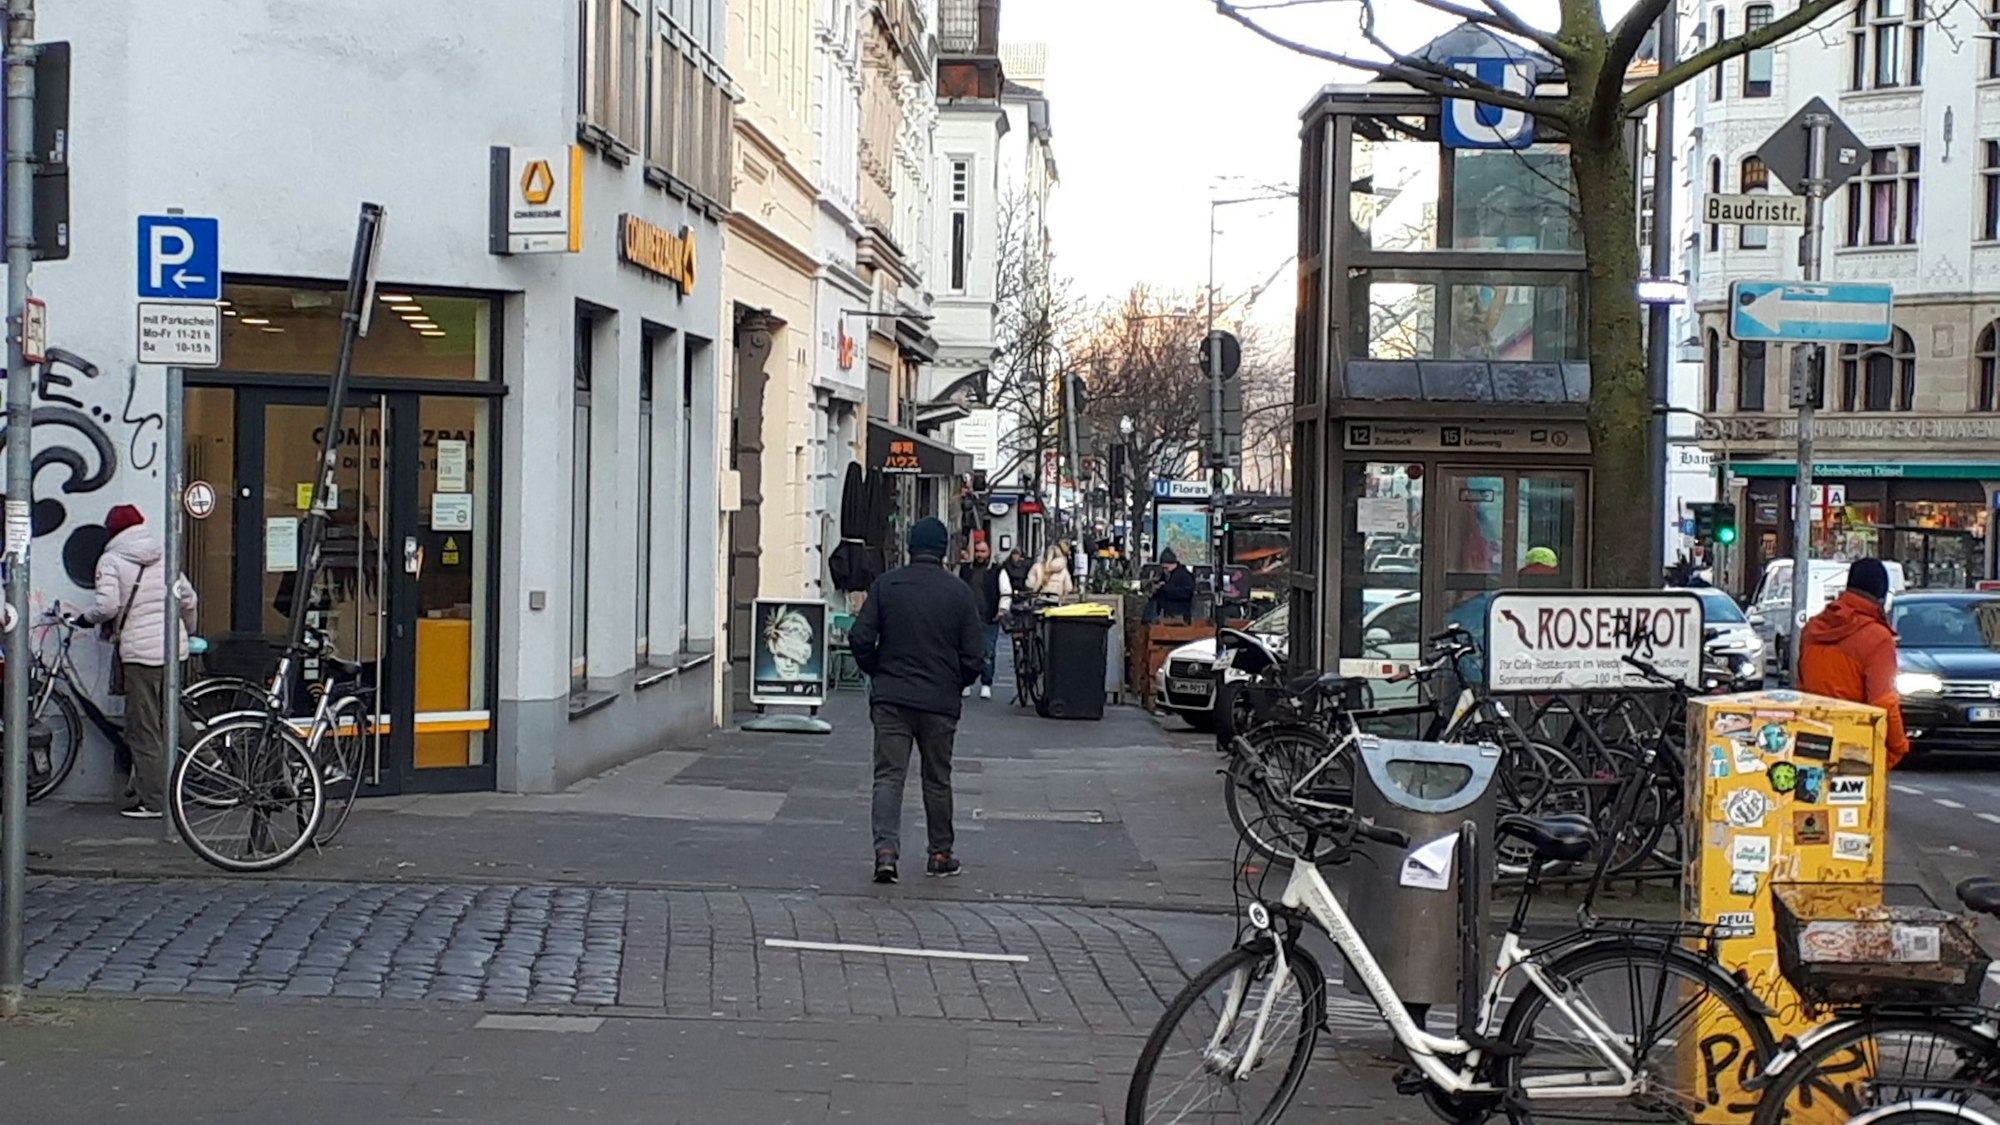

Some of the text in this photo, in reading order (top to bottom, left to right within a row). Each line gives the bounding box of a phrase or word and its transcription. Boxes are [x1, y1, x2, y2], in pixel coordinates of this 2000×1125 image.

[1453, 63, 1526, 143] U
[1709, 199, 1800, 221] Baudristr.
[625, 214, 684, 281] COMMERZBANK
[151, 225, 194, 288] P
[143, 315, 214, 326] mit Parkschein
[143, 328, 211, 340] Mo-Fr 11-21 h
[143, 341, 156, 352] Sa
[204, 343, 211, 353] h
[1352, 429, 1369, 442] 12
[1443, 431, 1459, 443] 15
